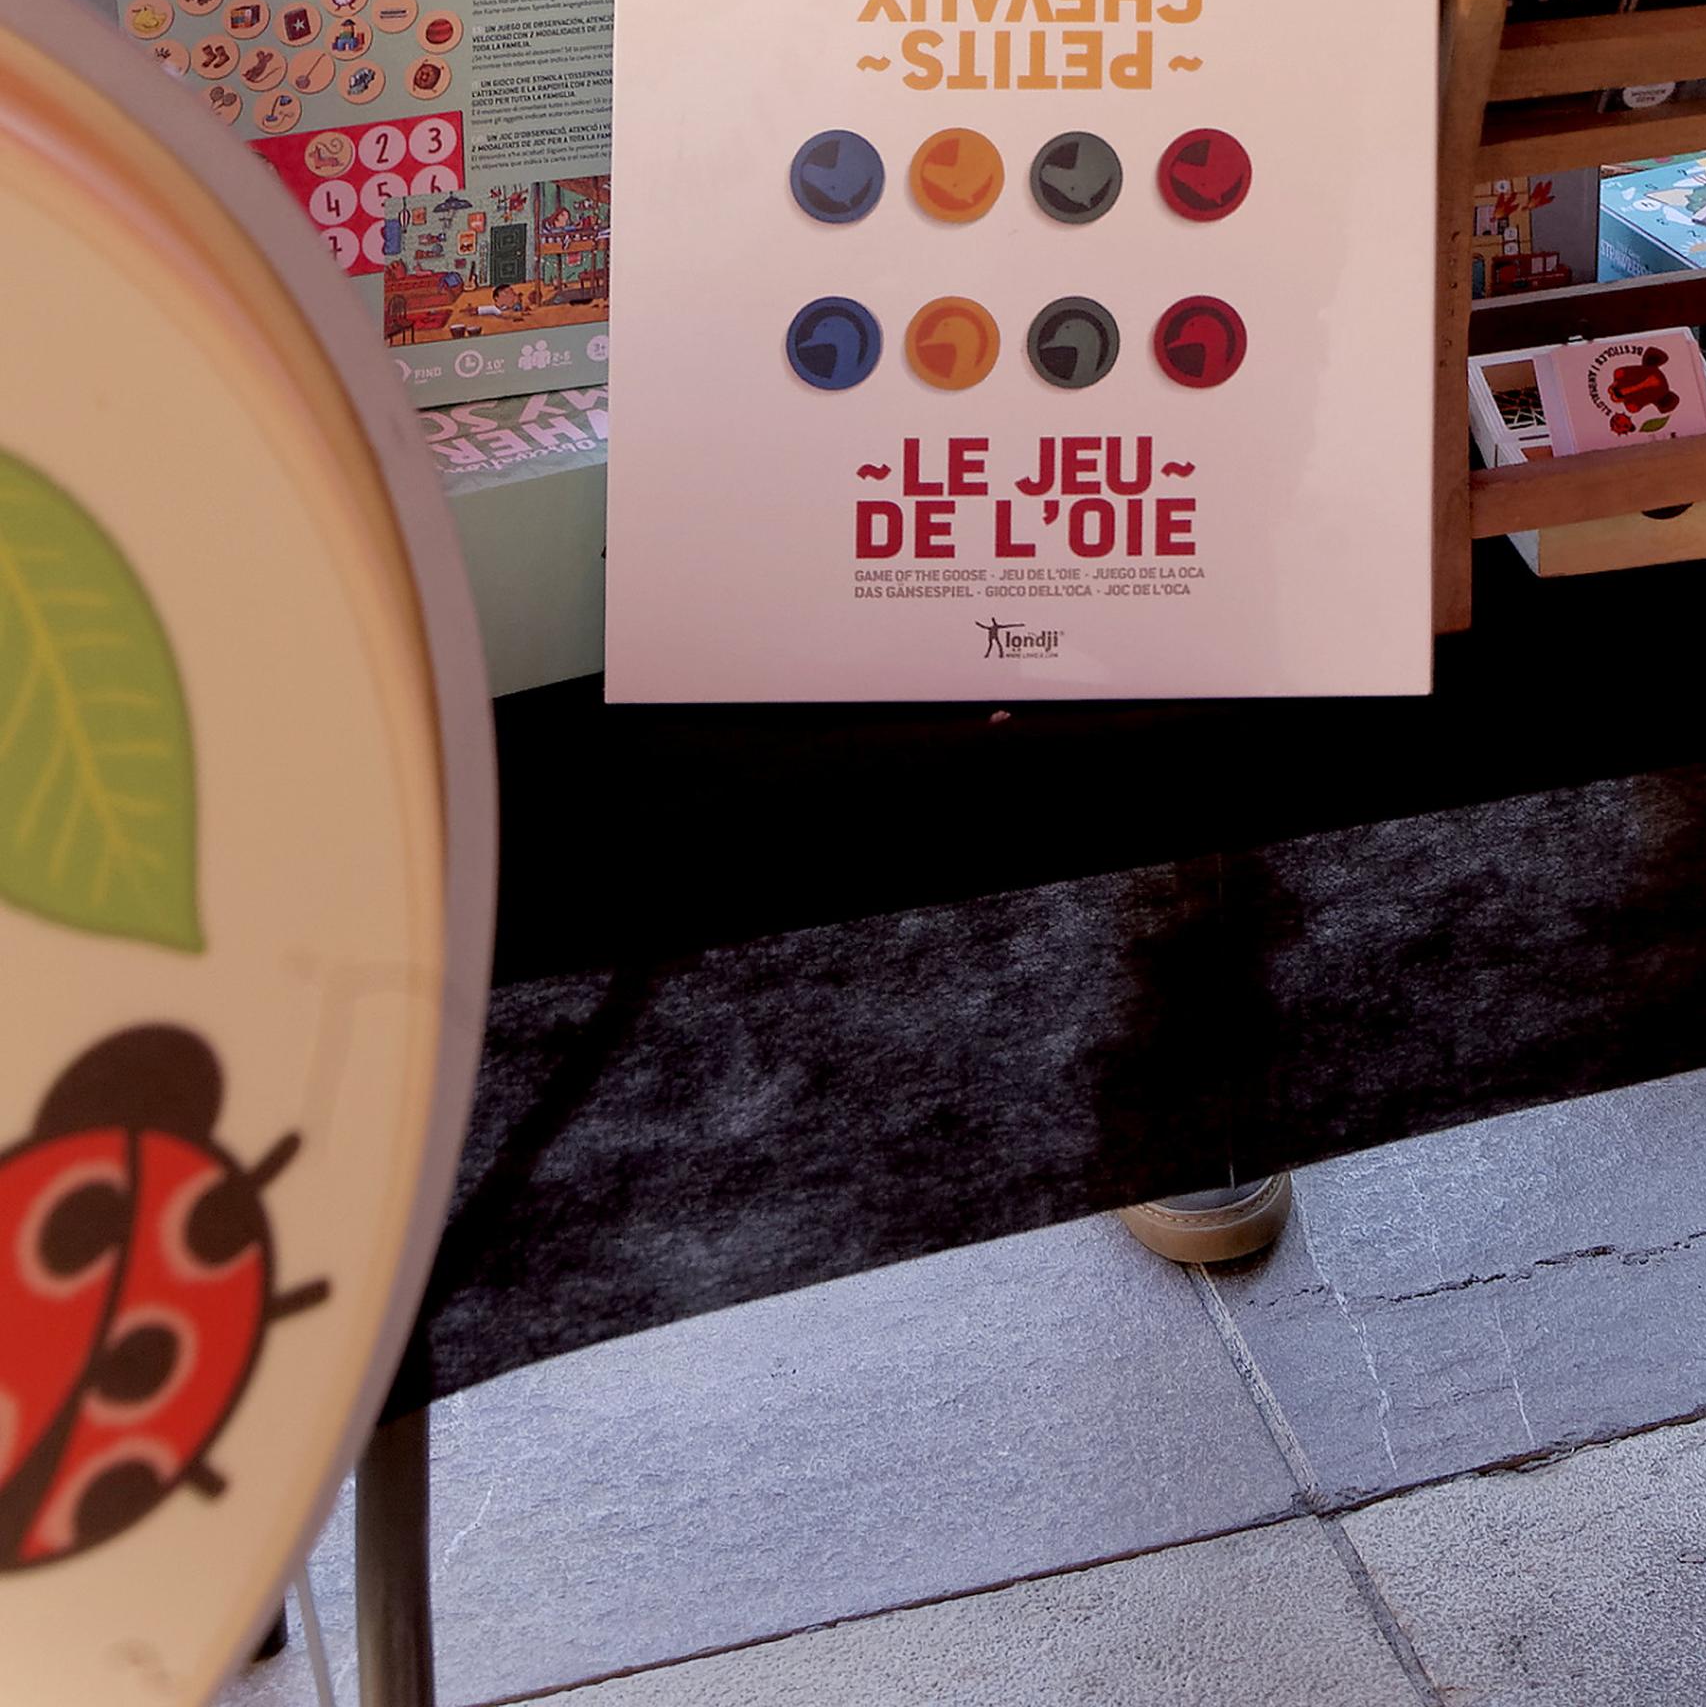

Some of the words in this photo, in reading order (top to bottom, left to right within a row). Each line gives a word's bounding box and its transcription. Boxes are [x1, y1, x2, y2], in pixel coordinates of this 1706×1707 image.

[900, 29, 1153, 91] PETITS
[375, 132, 389, 164] 2
[427, 127, 442, 154] 3
[325, 191, 340, 217] 4
[377, 181, 392, 207] 5
[414, 367, 442, 379] FIND
[903, 437, 989, 497] LE
[1014, 436, 1153, 497] JEU
[856, 499, 956, 559] DE
[995, 498, 1196, 559] L'OIE
[854, 585, 884, 599] DAS
[885, 583, 974, 599] GÄNSESPIEL
[984, 585, 1026, 598] GIOCO
[1027, 584, 1093, 597] DELL'OCA
[1103, 583, 1130, 596] JOC
[1131, 583, 1152, 596] DE
[1152, 583, 1191, 596] L'OCA
[855, 569, 894, 582] GAME
[895, 569, 914, 582] OF
[915, 569, 940, 582] THE
[942, 569, 987, 582] GOOSE
[999, 569, 1025, 581] JEU
[1026, 569, 1046, 581] DE
[1047, 568, 1081, 581] L'OIE
[1092, 567, 1136, 580] JUEGO
[1138, 567, 1157, 580] DE
[1158, 567, 1177, 579] LA
[1178, 566, 1206, 579] OCA
